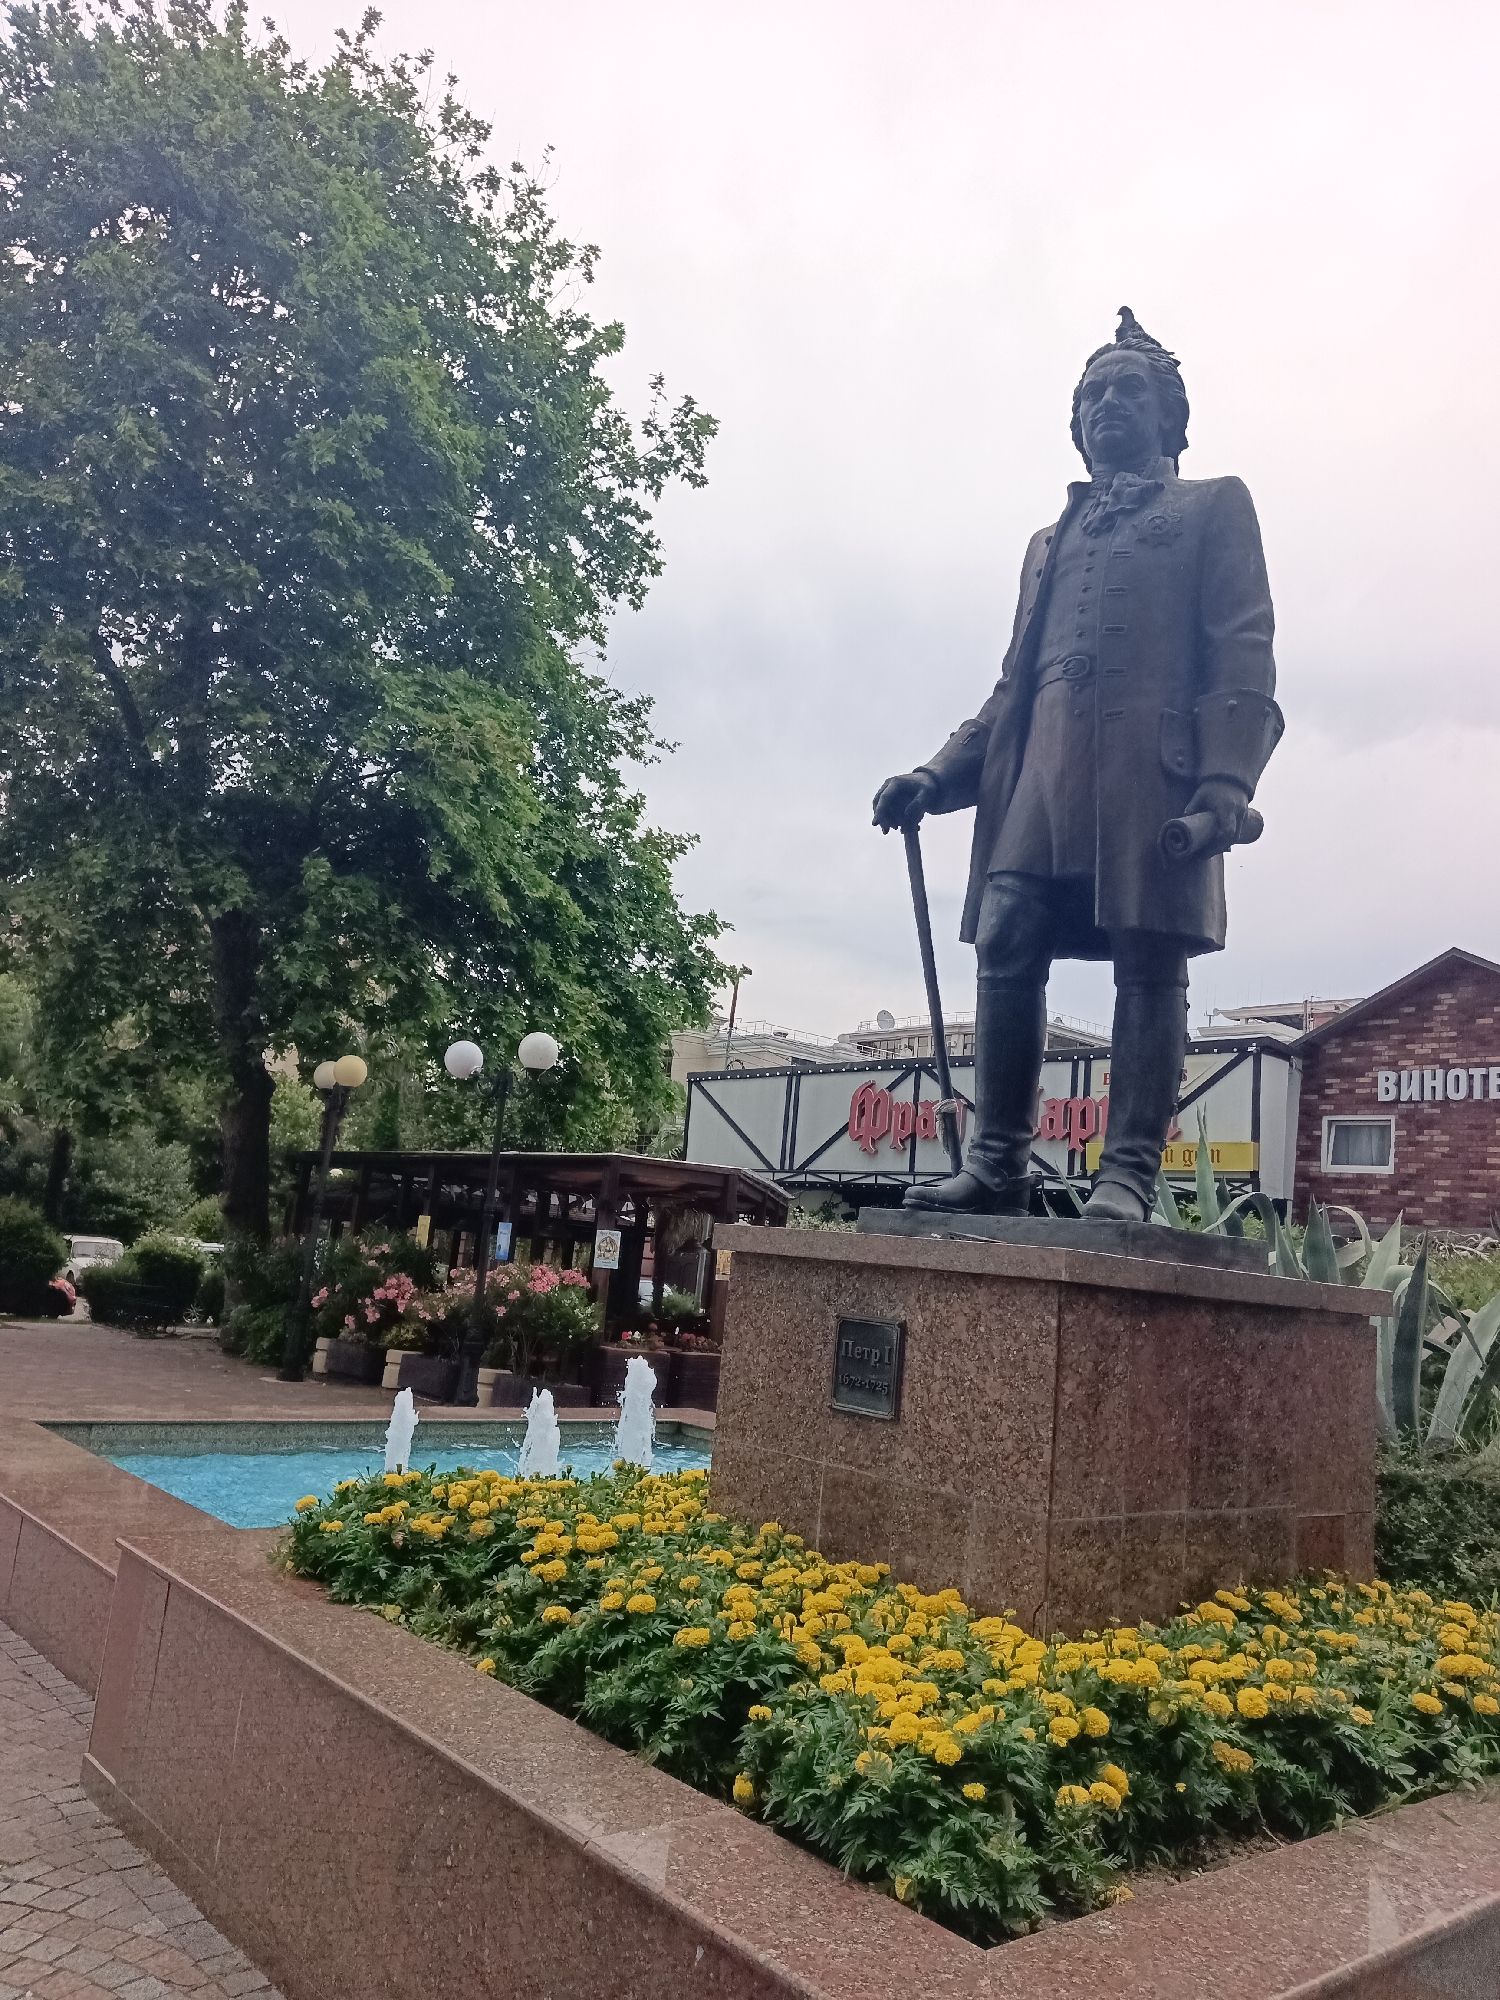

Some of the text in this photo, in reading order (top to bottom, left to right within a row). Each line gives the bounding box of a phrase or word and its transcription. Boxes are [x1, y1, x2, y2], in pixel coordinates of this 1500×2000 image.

[1377, 1067, 1500, 1102] ВИНОТЕ
[841, 1339, 880, 1368] Петр
[839, 1372, 889, 1395] 1672-1725
